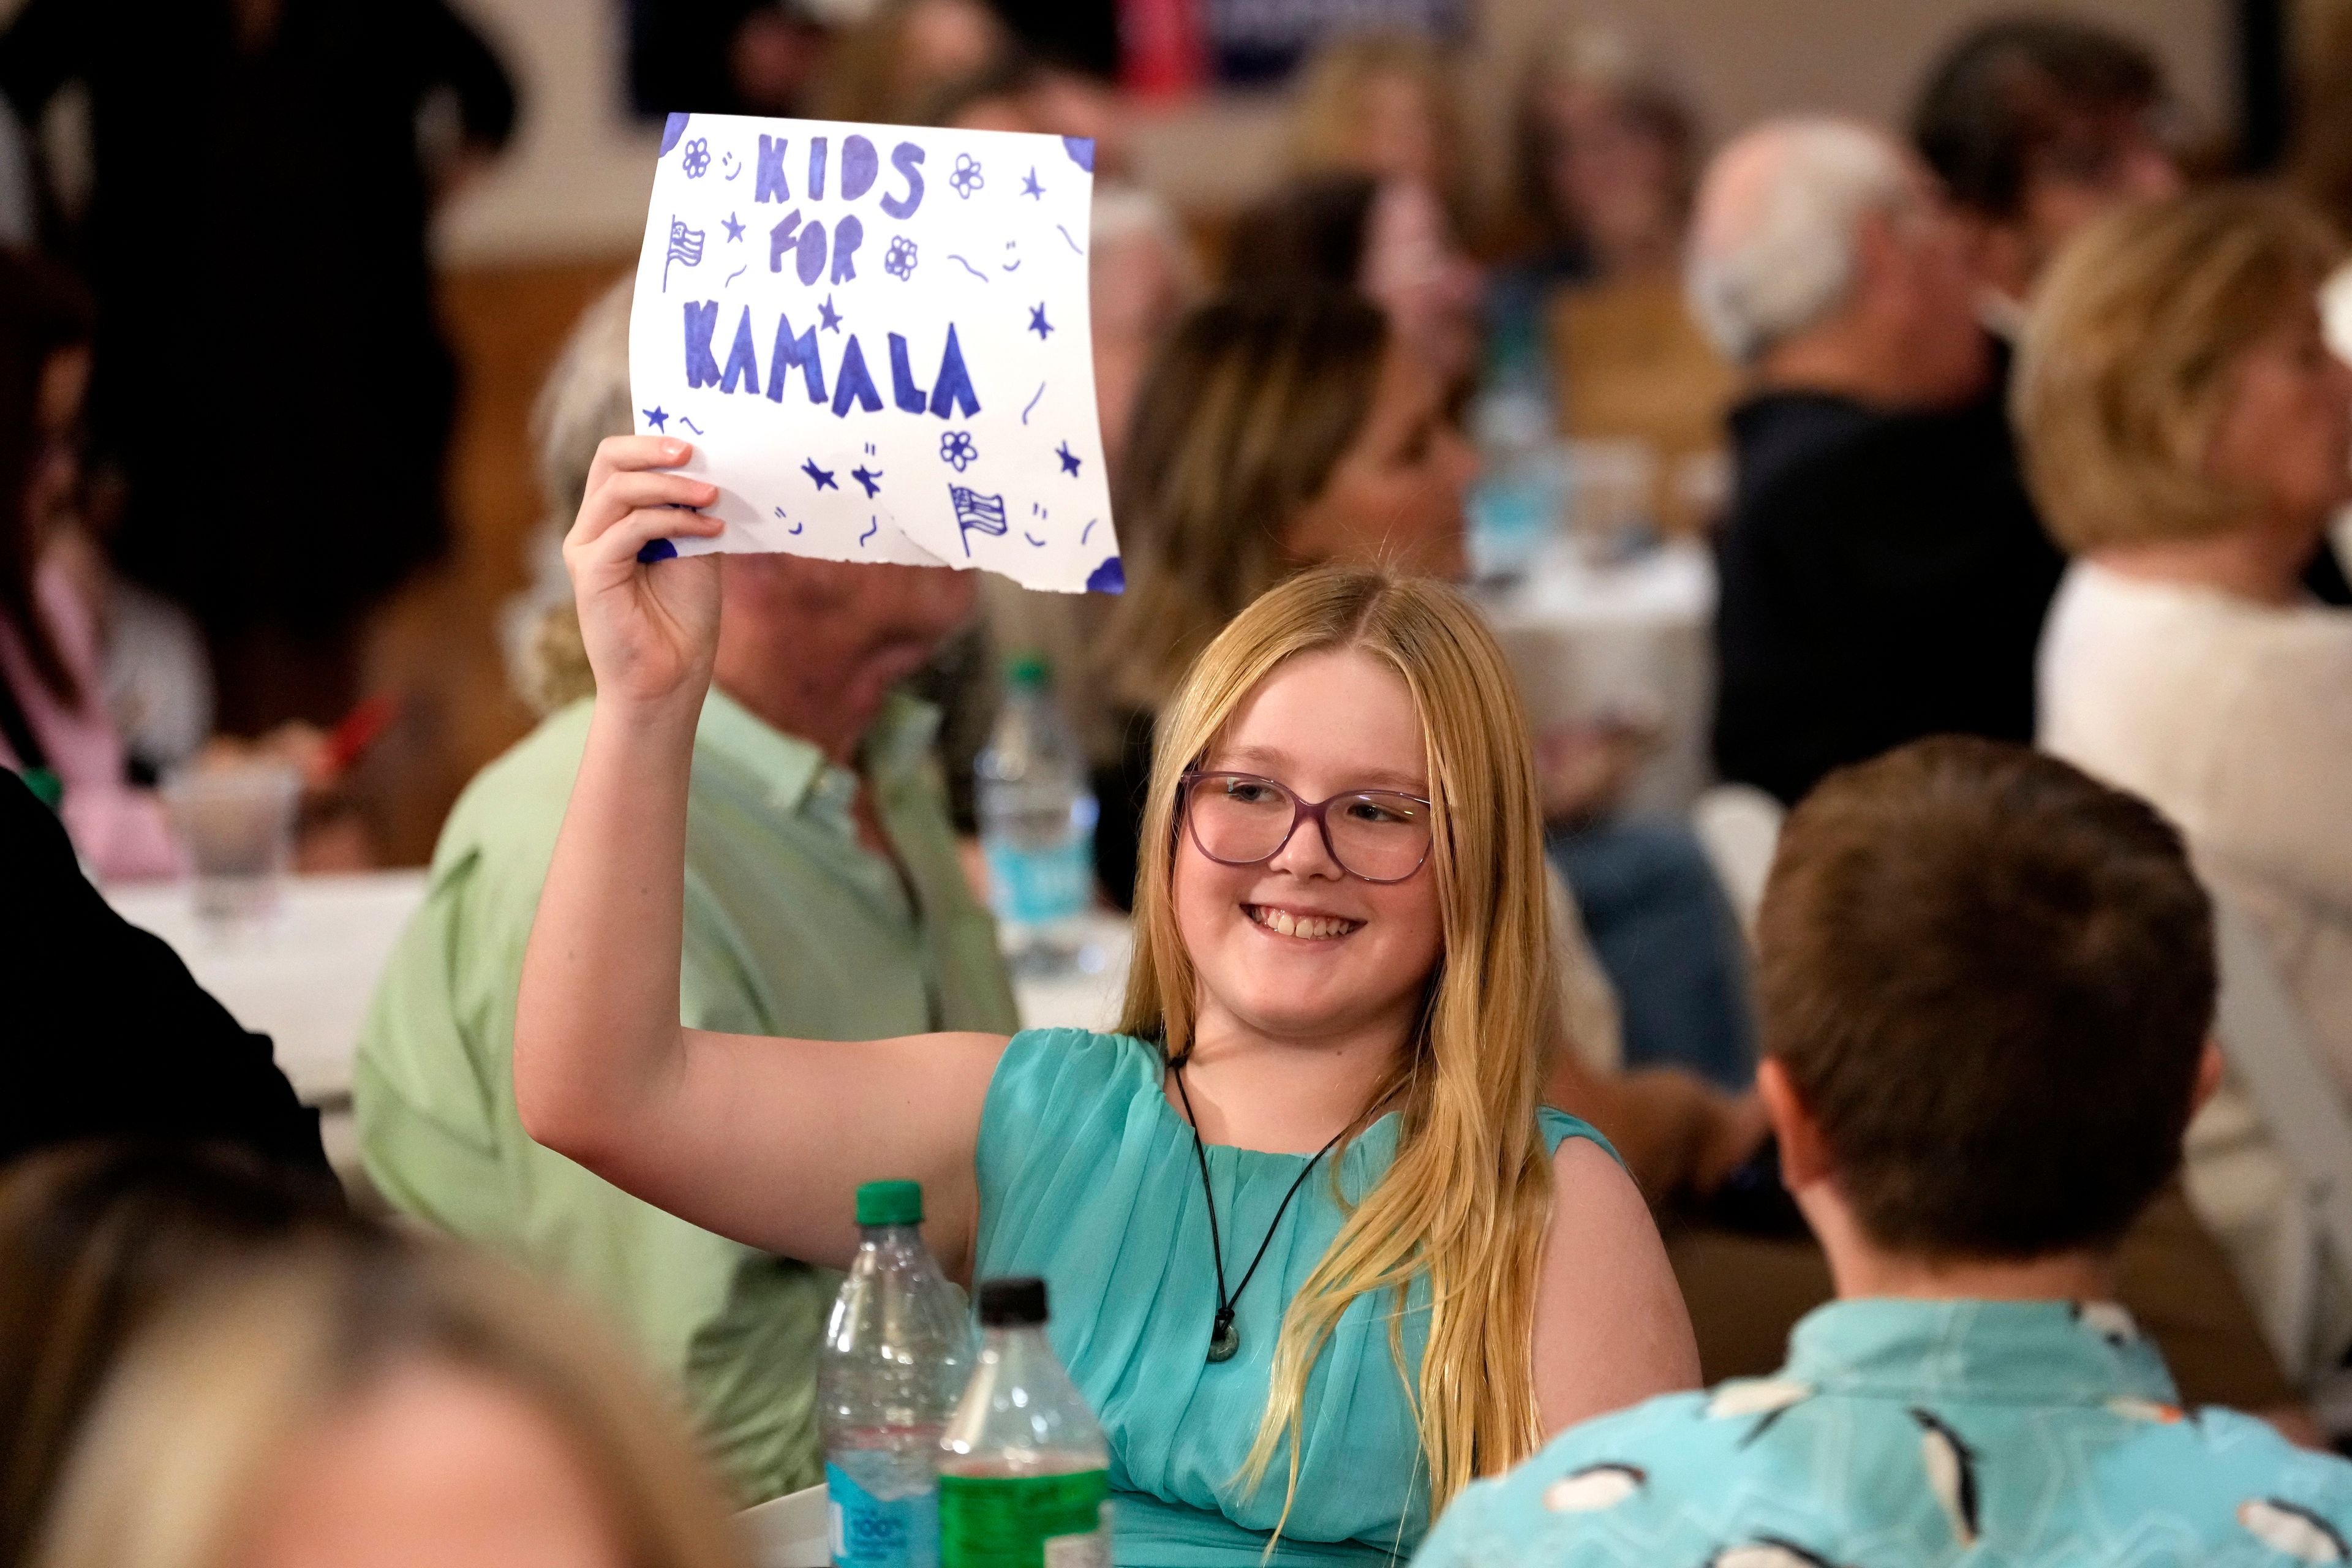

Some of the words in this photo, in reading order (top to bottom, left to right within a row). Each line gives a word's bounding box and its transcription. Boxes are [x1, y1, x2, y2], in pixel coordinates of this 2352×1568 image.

[755, 134, 925, 219] KIDS
[770, 209, 863, 285] FOR
[684, 300, 981, 419] KAMALA
